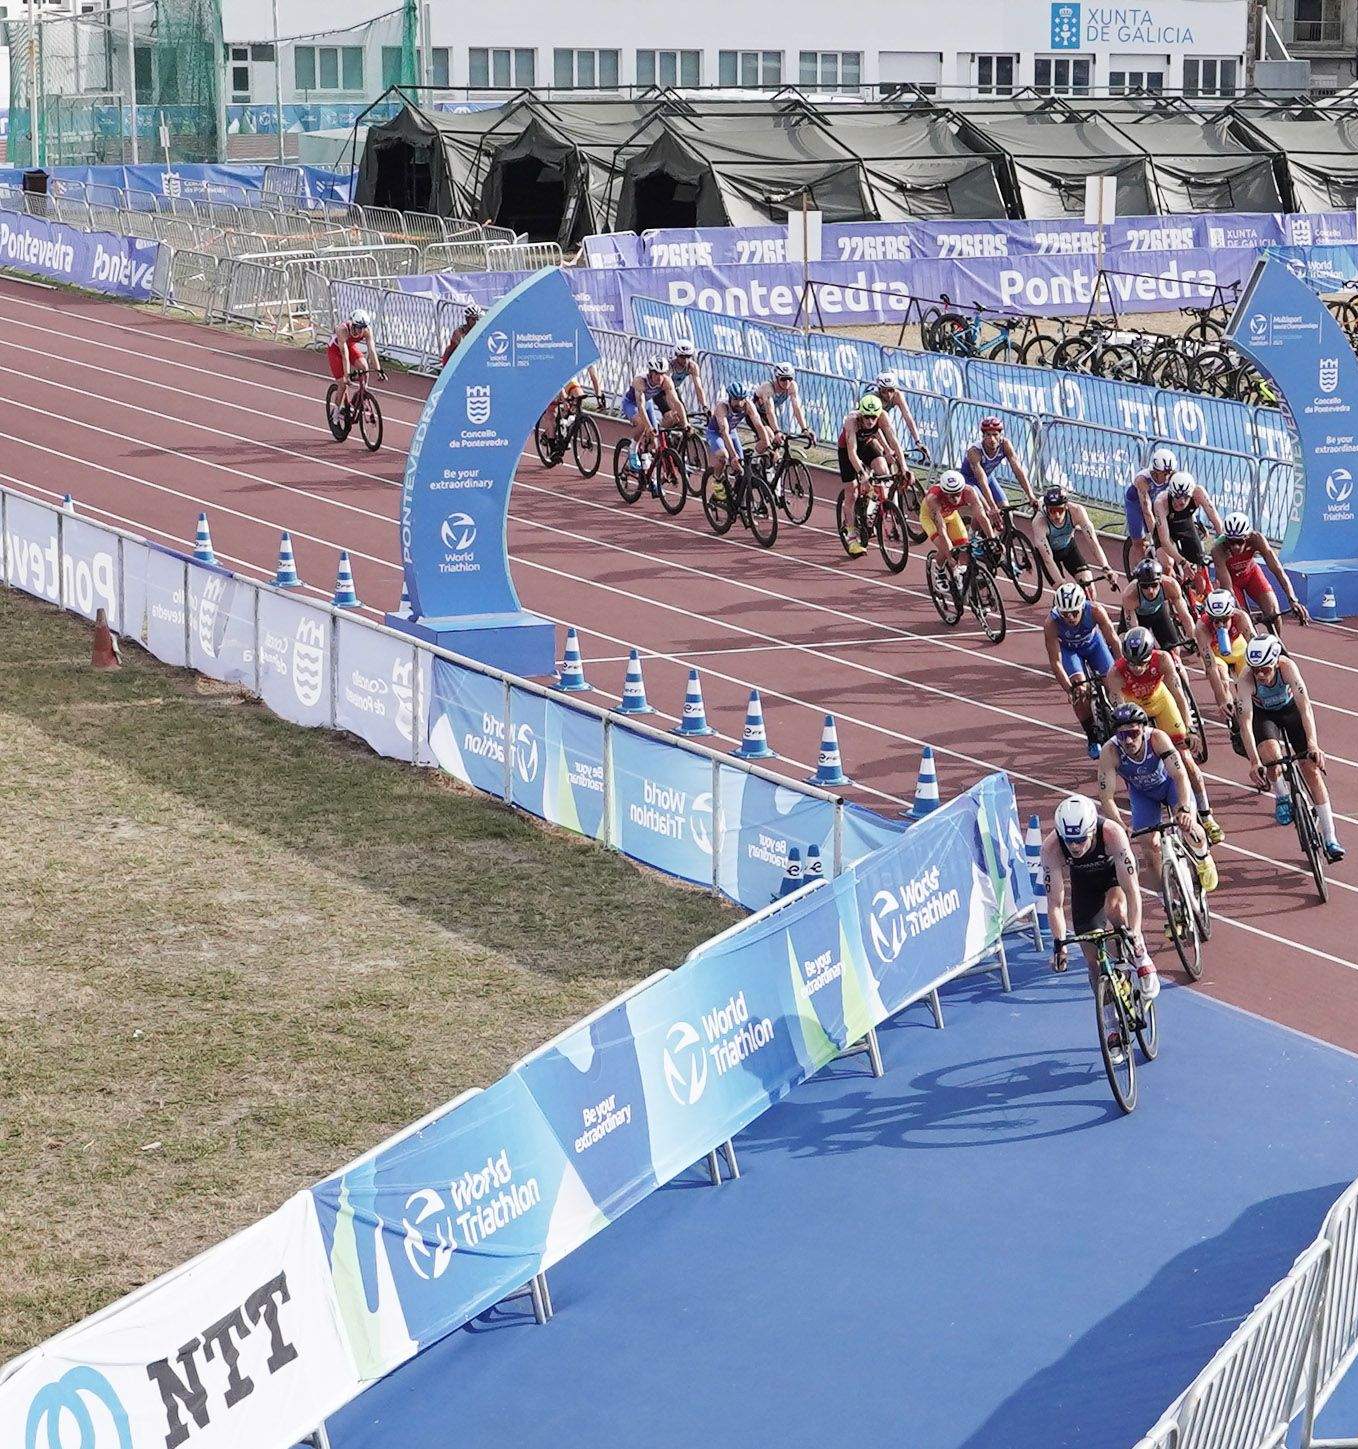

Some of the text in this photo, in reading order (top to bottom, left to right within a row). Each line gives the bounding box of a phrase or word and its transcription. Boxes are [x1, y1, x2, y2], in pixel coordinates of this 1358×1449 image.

[1087, 9, 1153, 26] XUNTA
[1087, 26, 1194, 44] DE GALICIA
[936, 234, 1008, 258] 226ERS
[1035, 230, 1107, 255] 226ERS
[1127, 227, 1194, 251] 226ERS
[1226, 229, 1257, 239] XUNTA
[1, 223, 73, 273] Pontevedra
[651, 242, 714, 267] 226ERS
[837, 235, 912, 261] 226ERS
[668, 271, 911, 317] Pontevedra
[999, 260, 1218, 307] Pontevedra
[516, 333, 552, 342] Multisport
[1304, 404, 1351, 414] de Pontevedra
[1313, 397, 1342, 406] Concello
[449, 438, 509, 448] de Pontevedra
[461, 429, 497, 438] Concello
[1326, 435, 1354, 445] Be your
[402, 388, 444, 563] PONTEVEDRA
[430, 478, 494, 490] extraordinary
[444, 469, 479, 480] Be your
[1323, 511, 1355, 521] Triathlon
[1327, 502, 1350, 512] World
[438, 562, 480, 573] Triathlon
[445, 552, 474, 562] World
[899, 865, 940, 913] World
[905, 887, 960, 938] Triathlon
[805, 948, 832, 977] Be your
[701, 991, 749, 1043] World
[709, 1016, 774, 1076] Triathlon
[582, 1093, 617, 1127] Be your
[574, 1102, 632, 1154] extraordinary
[450, 1148, 512, 1207] World
[456, 1176, 540, 1247] Triathlon
[146, 1269, 299, 1449] NTT
